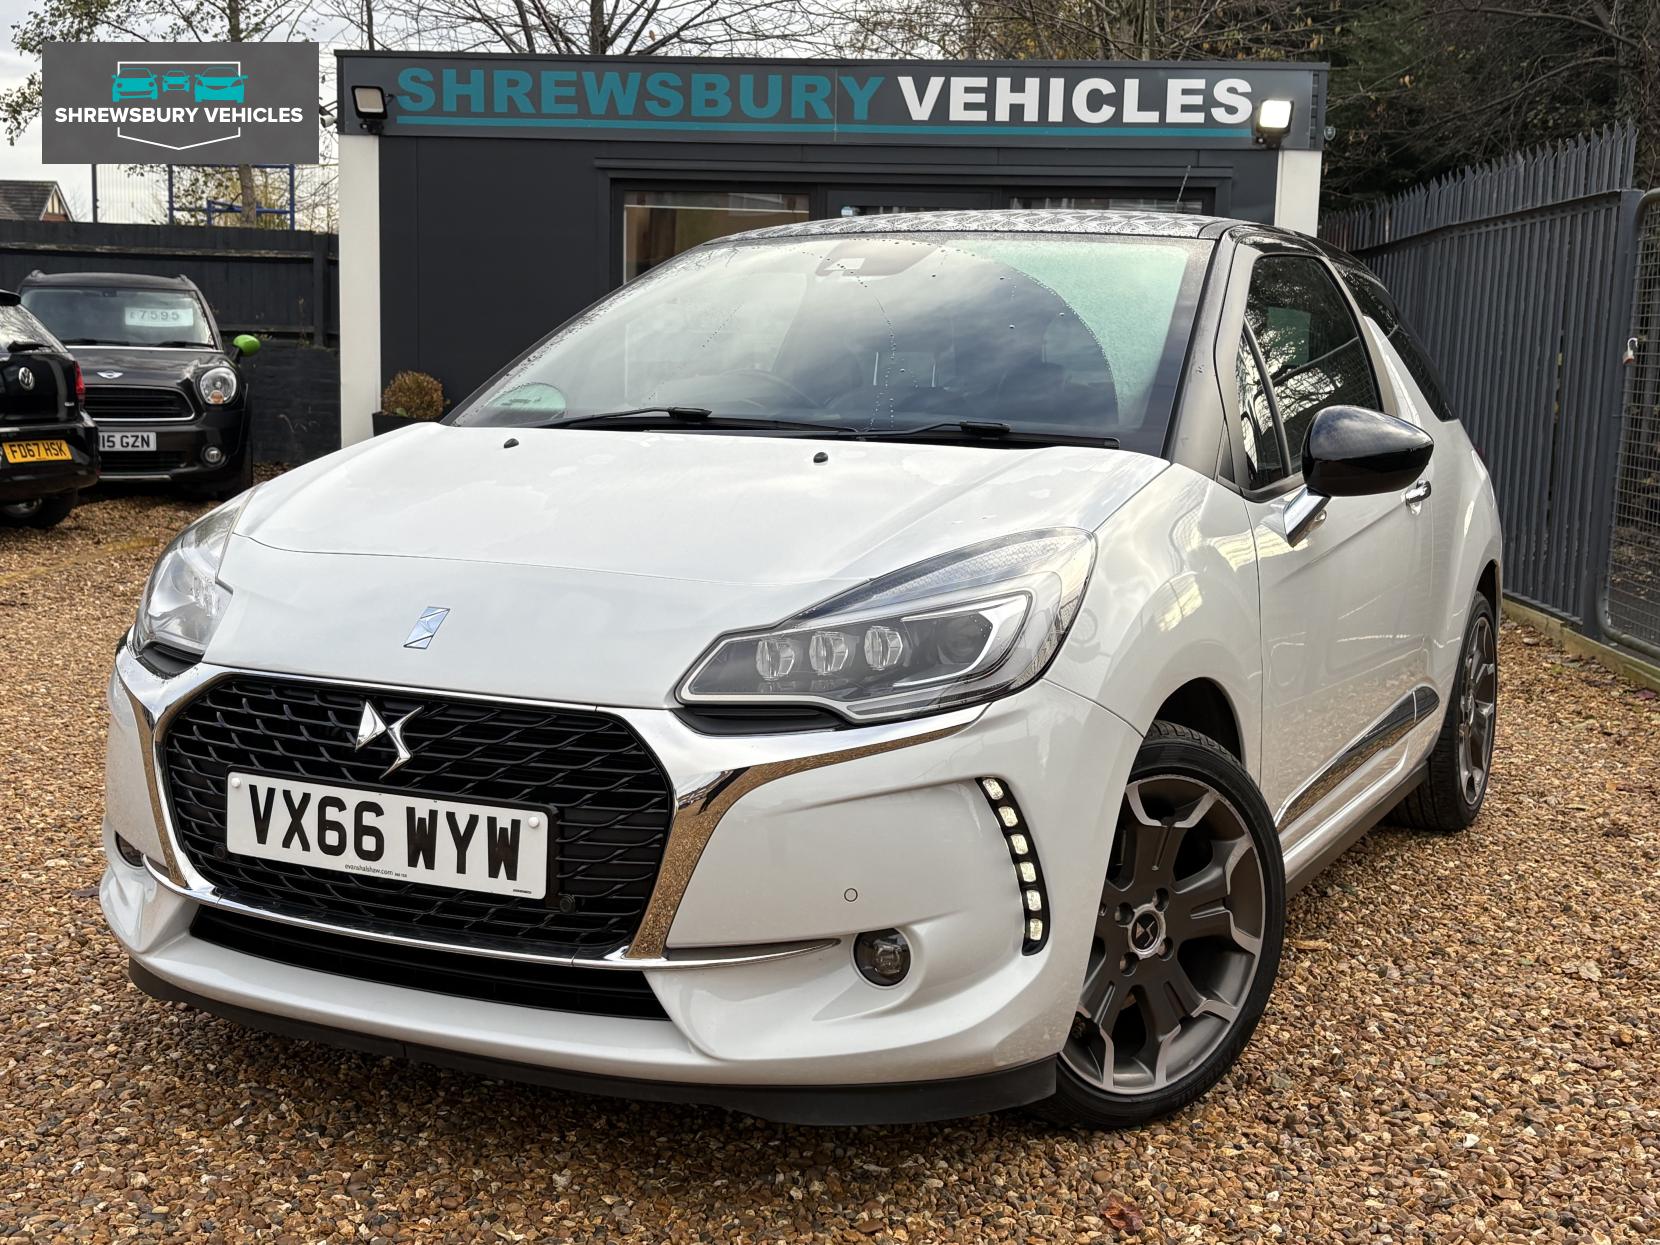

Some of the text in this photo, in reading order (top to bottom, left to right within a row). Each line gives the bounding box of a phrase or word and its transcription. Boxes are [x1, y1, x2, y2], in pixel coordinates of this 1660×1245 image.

[397, 67, 1253, 124] SHREWSBURY VEHICLES
[9, 440, 67, 460] FD67 HSK
[120, 434, 150, 449] GZN
[248, 783, 521, 882] VX66 WYW
